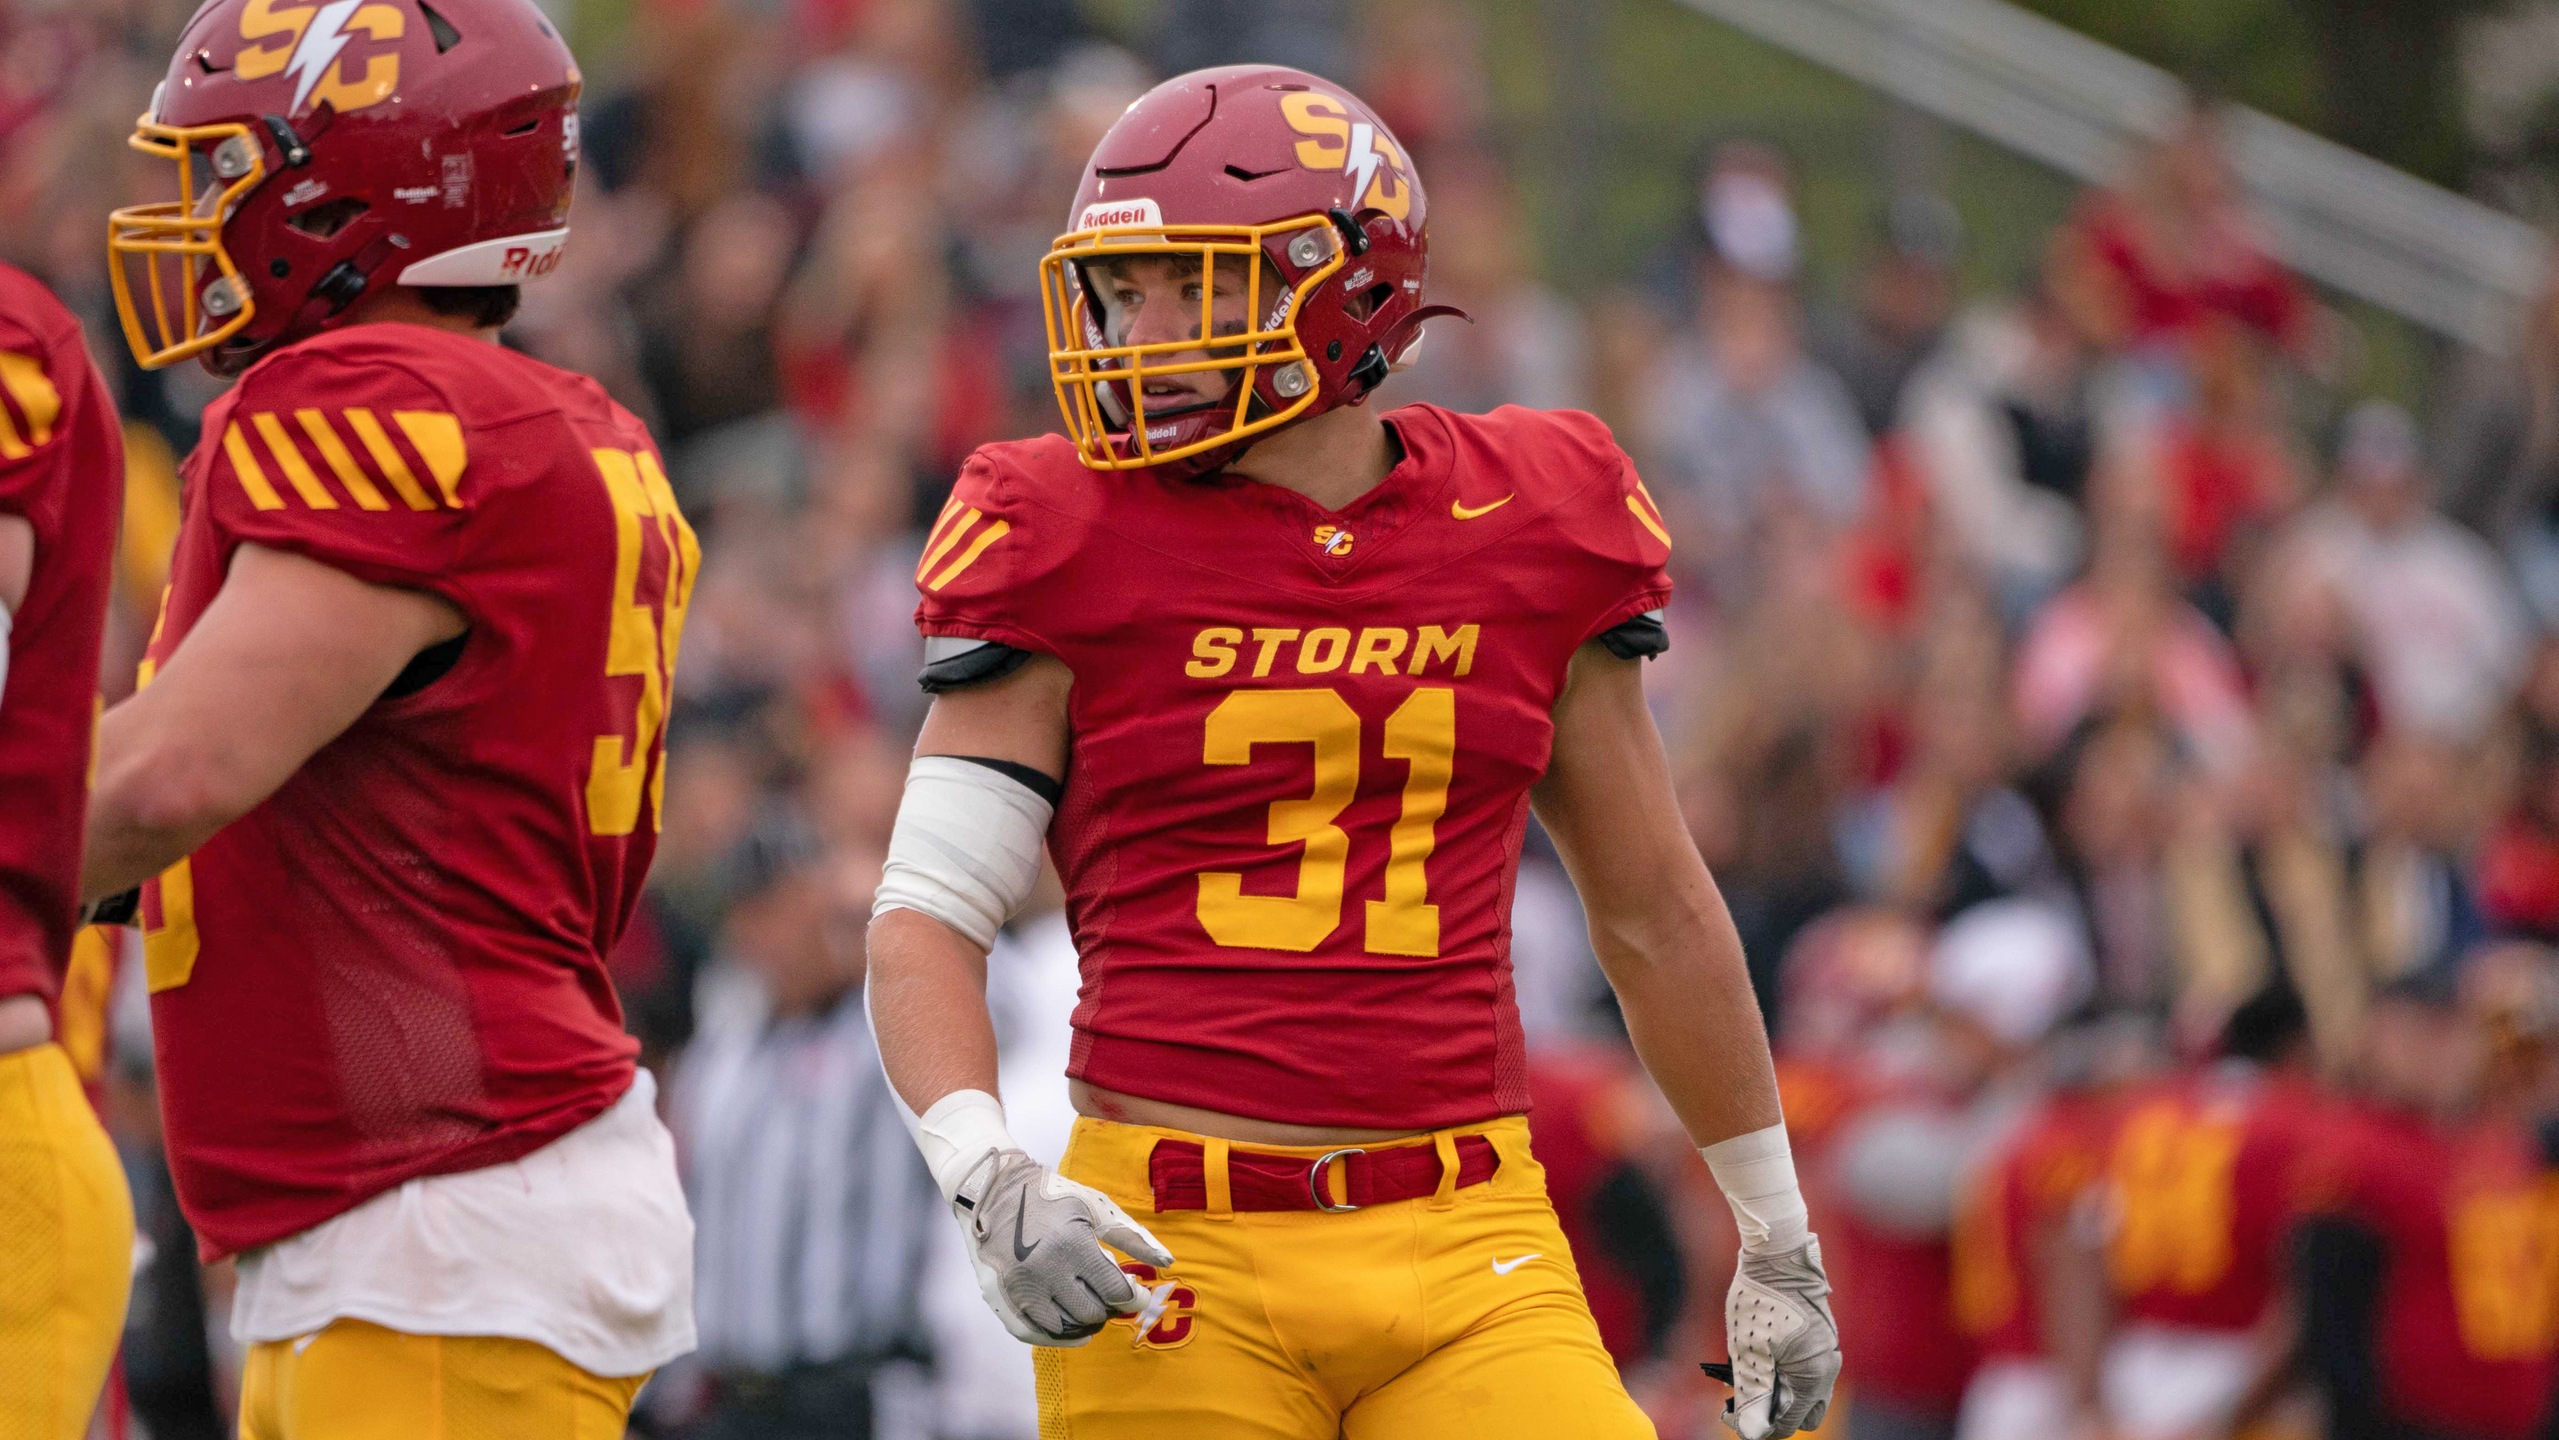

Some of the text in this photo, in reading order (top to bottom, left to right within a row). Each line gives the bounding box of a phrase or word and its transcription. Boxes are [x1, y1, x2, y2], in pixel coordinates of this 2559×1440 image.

[1281, 93, 1411, 220] SC
[1083, 208, 1146, 229] Riddell
[1313, 525, 1354, 556] SC
[1185, 624, 1481, 678] STORM
[1195, 687, 1456, 957] 31
